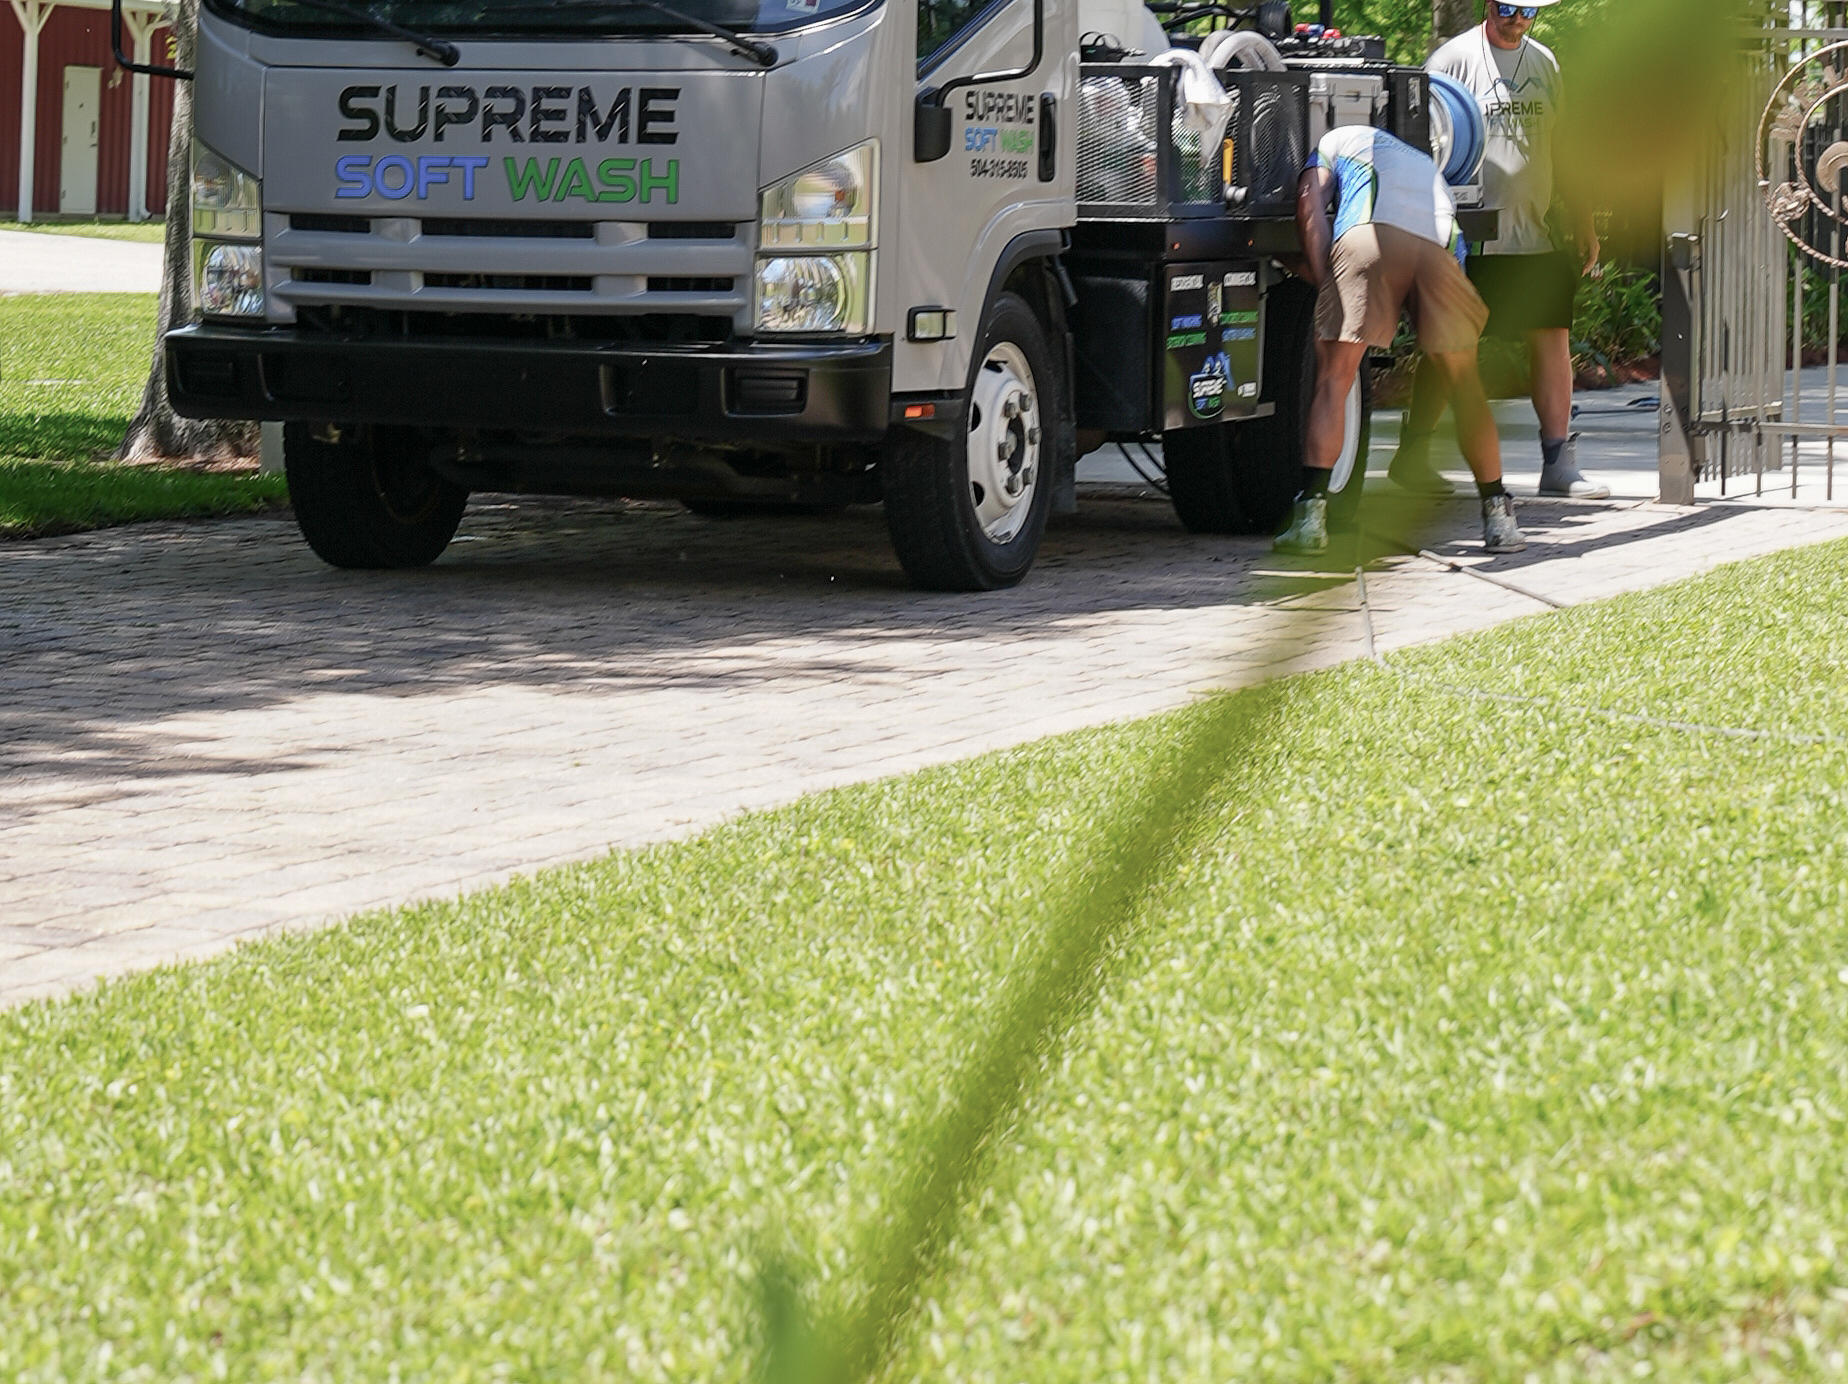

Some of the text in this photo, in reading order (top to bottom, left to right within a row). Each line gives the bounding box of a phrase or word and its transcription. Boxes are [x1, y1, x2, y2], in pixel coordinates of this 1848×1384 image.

[336, 85, 683, 145] SUPREME
[965, 90, 1035, 124] SUPREME
[1485, 101, 1544, 116] PREME
[964, 127, 1035, 154] SOFT WASH
[334, 155, 681, 204] SOFT WASH
